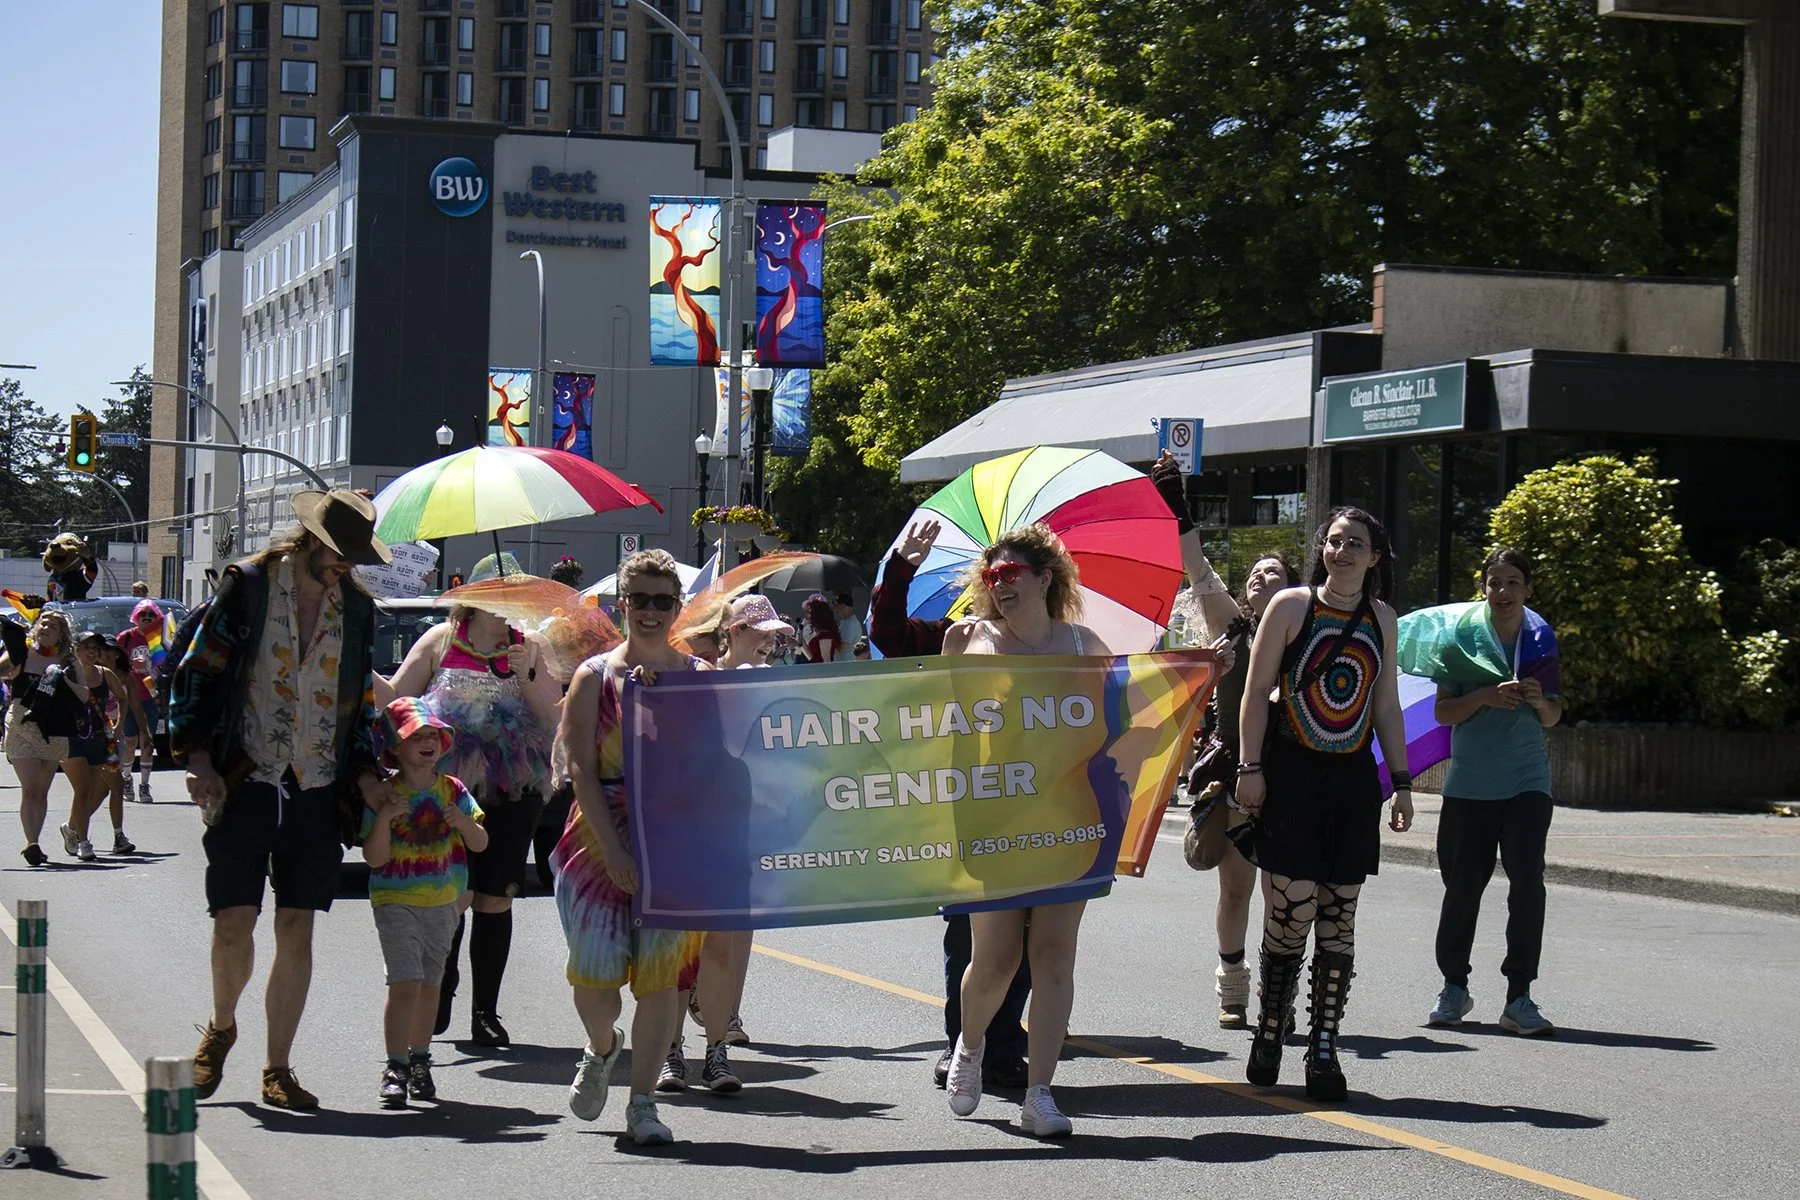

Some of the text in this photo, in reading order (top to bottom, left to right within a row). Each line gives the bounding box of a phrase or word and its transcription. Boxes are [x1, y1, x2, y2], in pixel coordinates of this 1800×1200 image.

[435, 175, 484, 201] BW
[531, 165, 598, 194] Best
[503, 191, 627, 223] Western
[1350, 385, 1373, 407] Glenn
[1382, 379, 1415, 403] Sinclair,
[102, 434, 138, 445] Church St.
[420, 555, 429, 563] CITY
[390, 580, 399, 588] CITY
[760, 694, 1096, 749] HAIR HAS NO
[824, 761, 1038, 812] GENDER
[760, 849, 870, 871] SERENITY
[877, 841, 953, 863] SALON
[971, 823, 1107, 856] 250-758-9985
